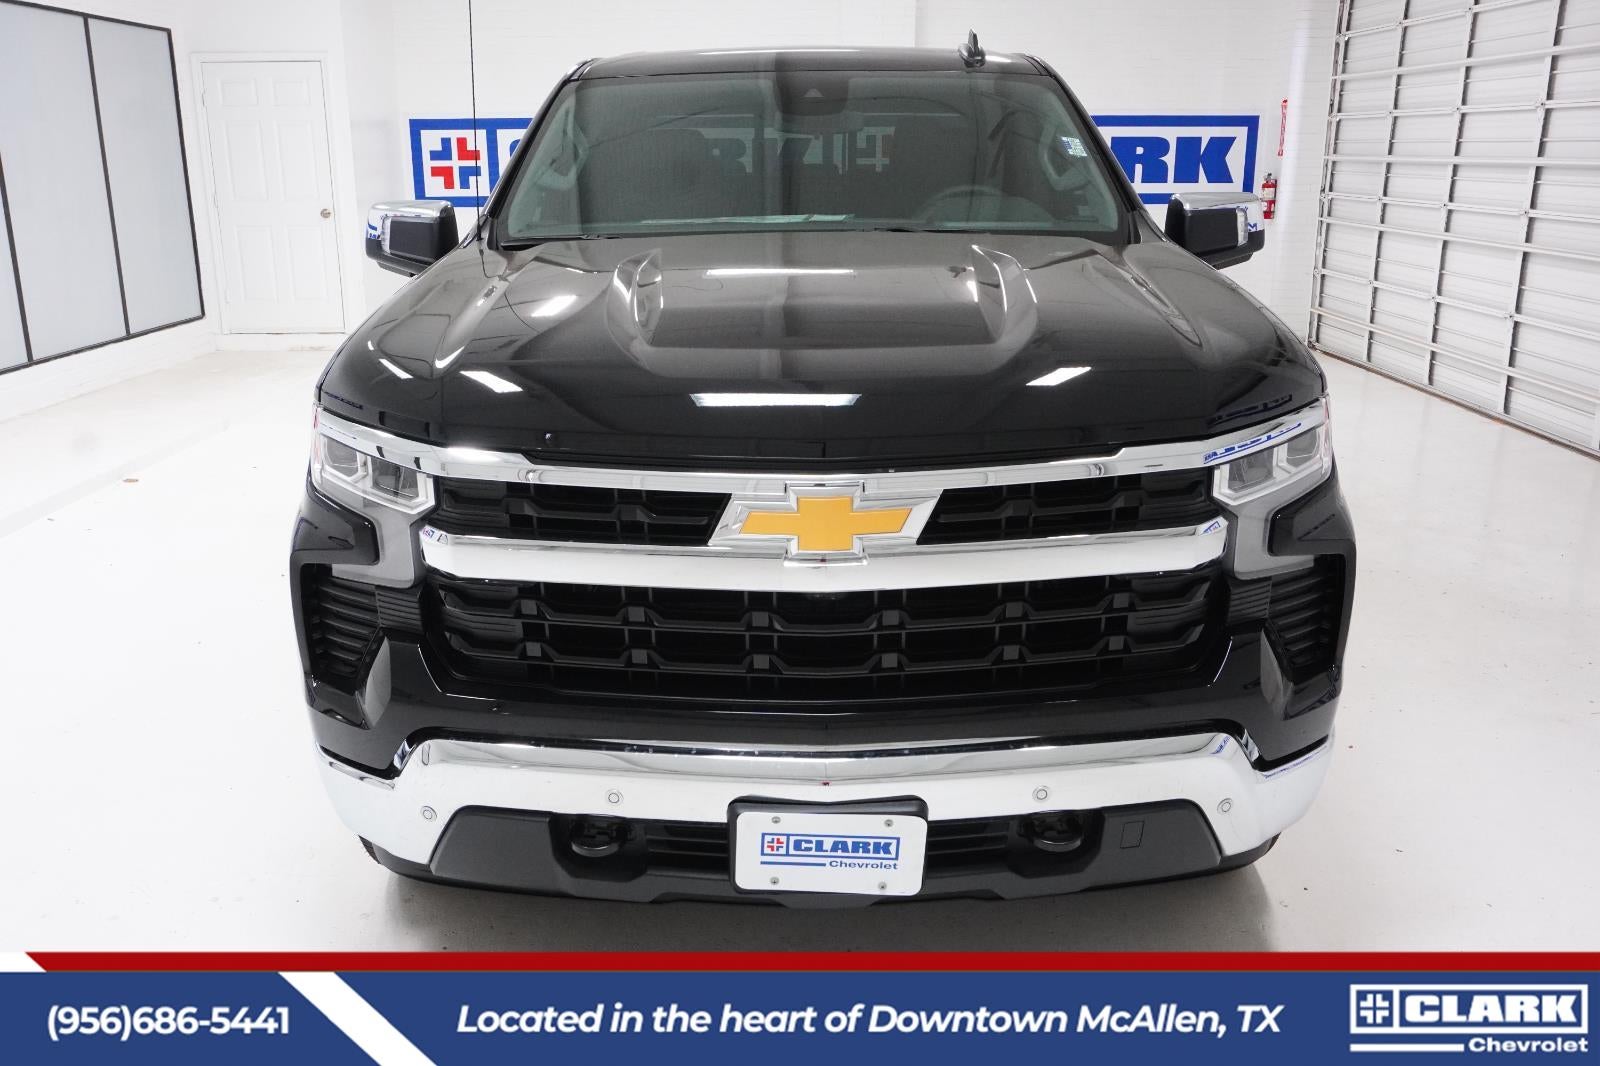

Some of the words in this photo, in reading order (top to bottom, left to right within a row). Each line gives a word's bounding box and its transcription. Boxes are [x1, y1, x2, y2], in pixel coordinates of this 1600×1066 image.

[1111, 136, 1236, 184] RK
[792, 838, 893, 856] CLARK
[829, 859, 899, 870] Chevrolet
